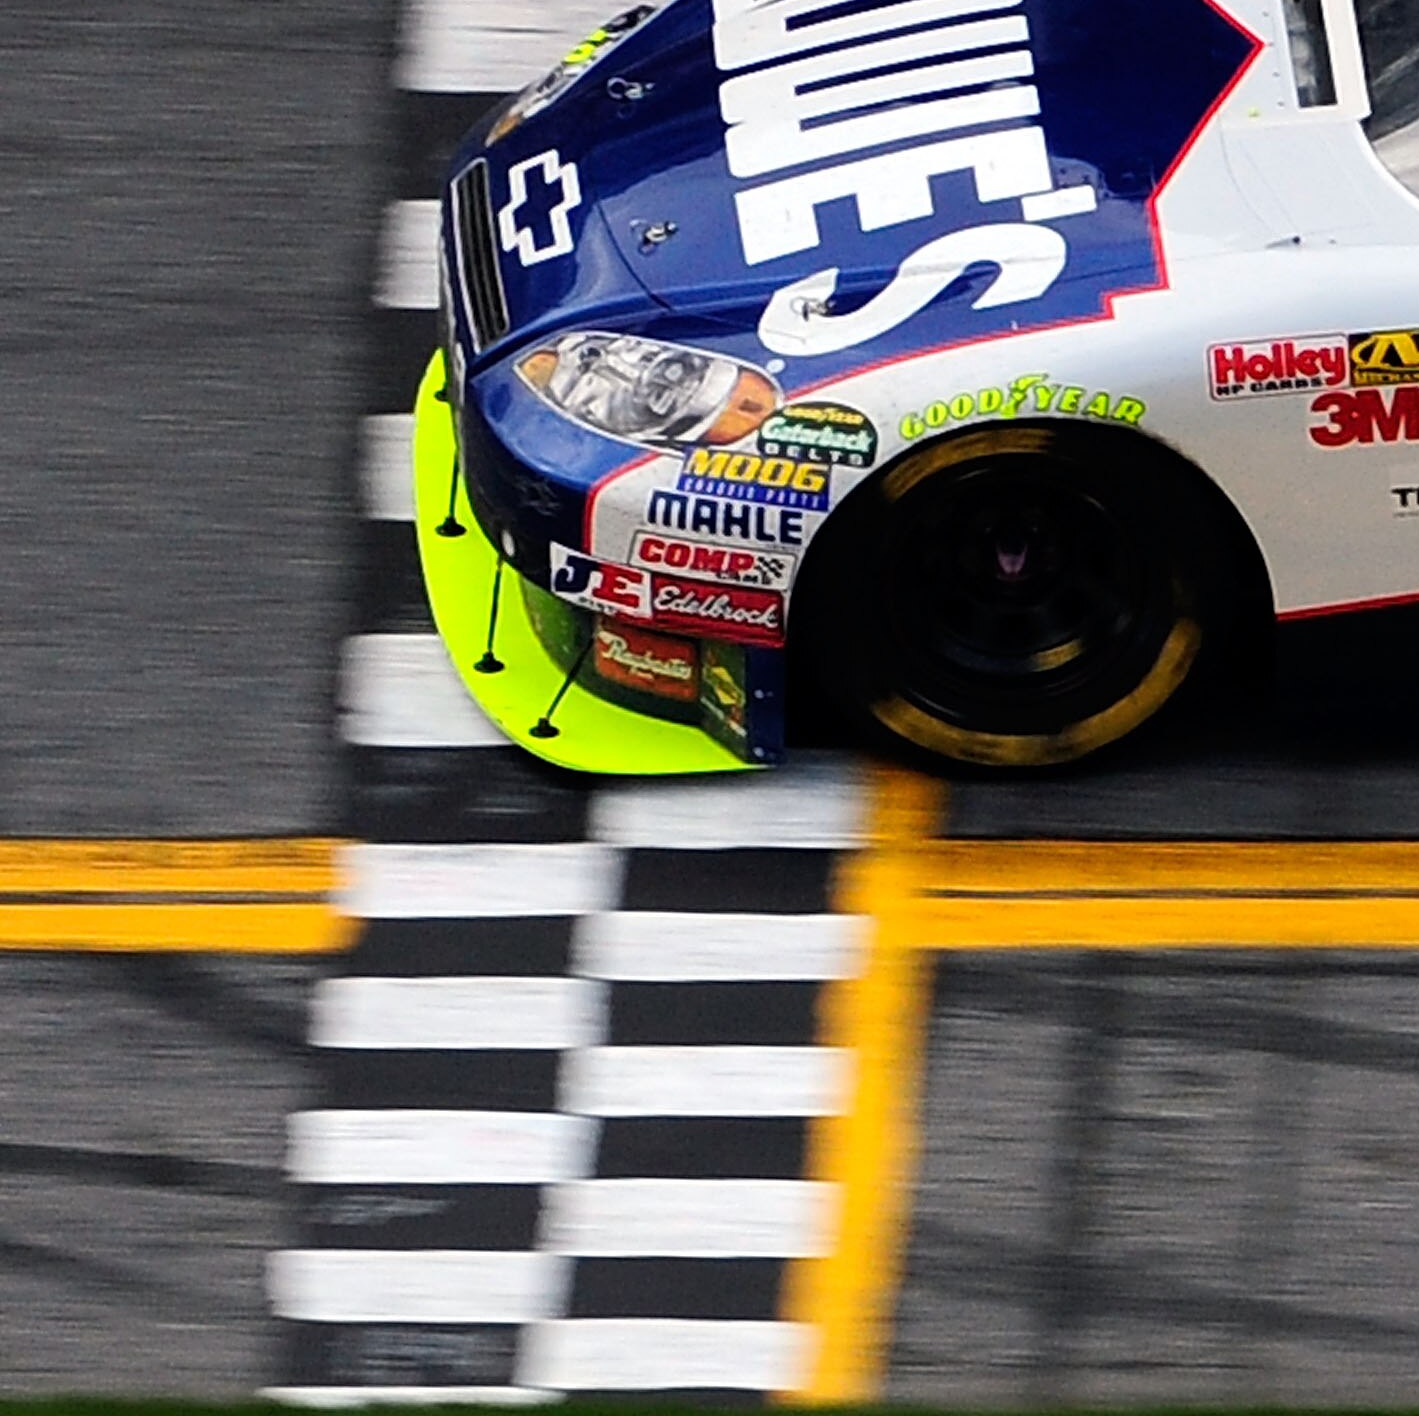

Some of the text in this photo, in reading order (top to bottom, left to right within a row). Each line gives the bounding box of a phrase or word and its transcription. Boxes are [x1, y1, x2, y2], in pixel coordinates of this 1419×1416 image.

[1213, 340, 1346, 386] Holley
[899, 374, 1146, 441] GOODYEAR
[683, 448, 826, 493] MOOG
[648, 491, 803, 545] MAHLE
[639, 537, 755, 574] COMP
[554, 554, 644, 610] JE
[653, 584, 779, 628] Edelbrock
